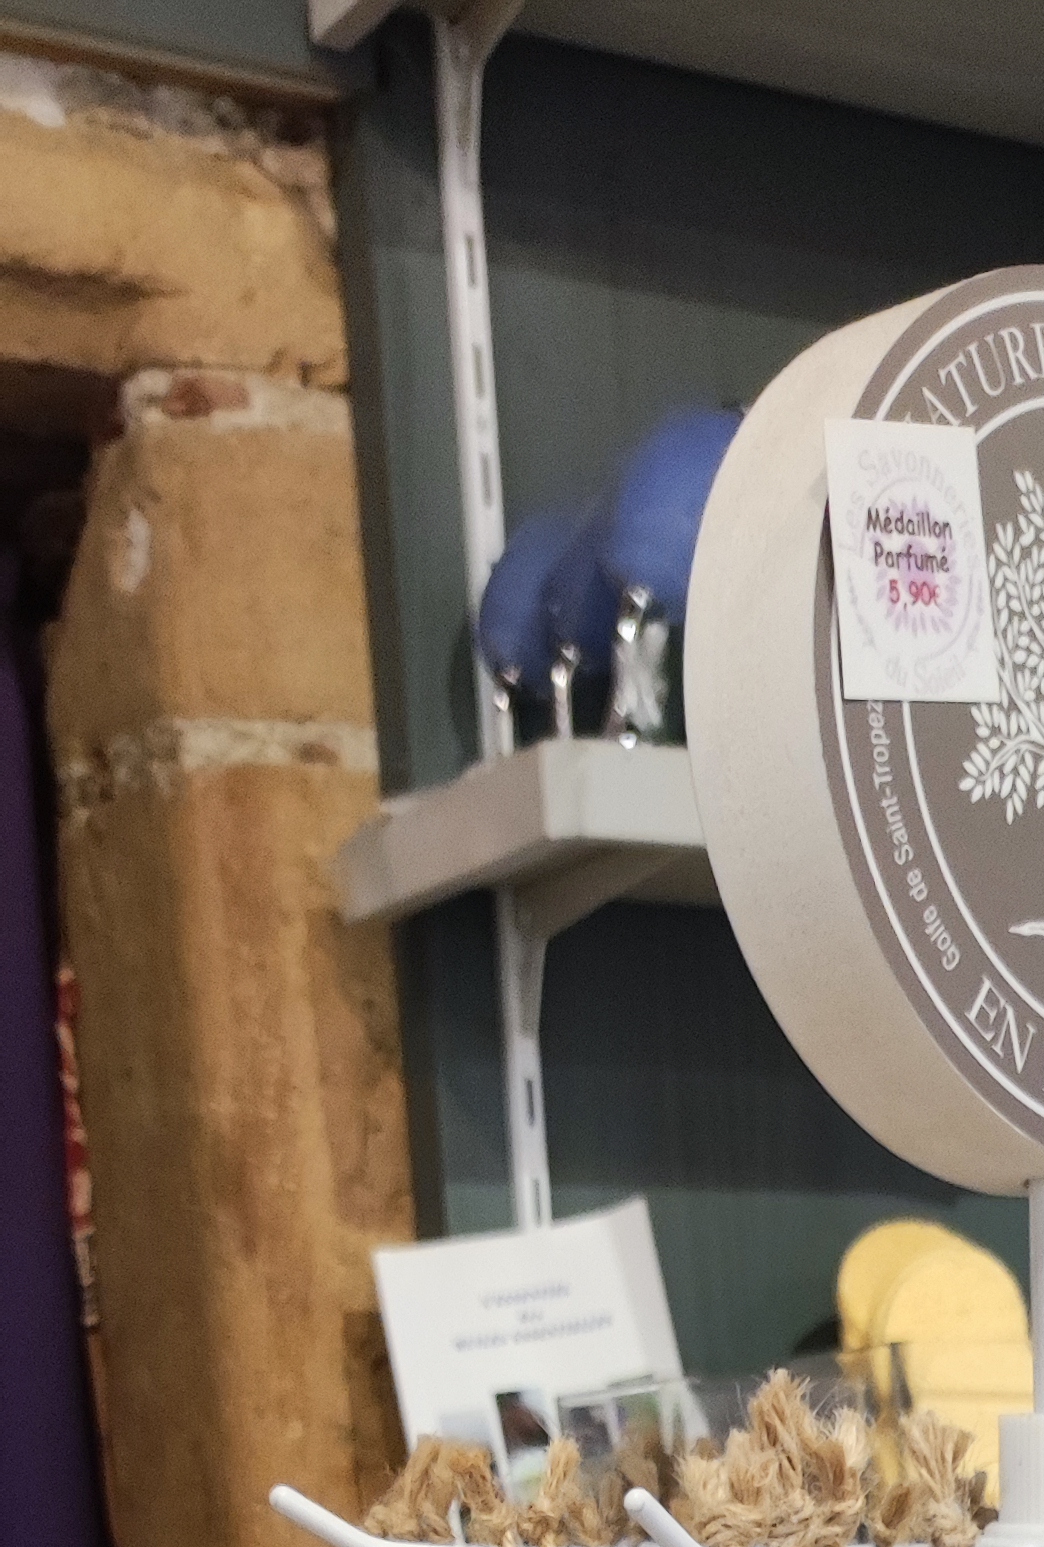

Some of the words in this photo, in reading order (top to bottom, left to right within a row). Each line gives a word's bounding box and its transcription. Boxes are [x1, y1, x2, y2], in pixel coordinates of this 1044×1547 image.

[866, 505, 952, 540] Médaillon
[873, 541, 950, 573] Parfumé
[907, 867, 928, 902] de
[923, 904, 960, 972] Golfe
[965, 975, 1037, 1074] EN
